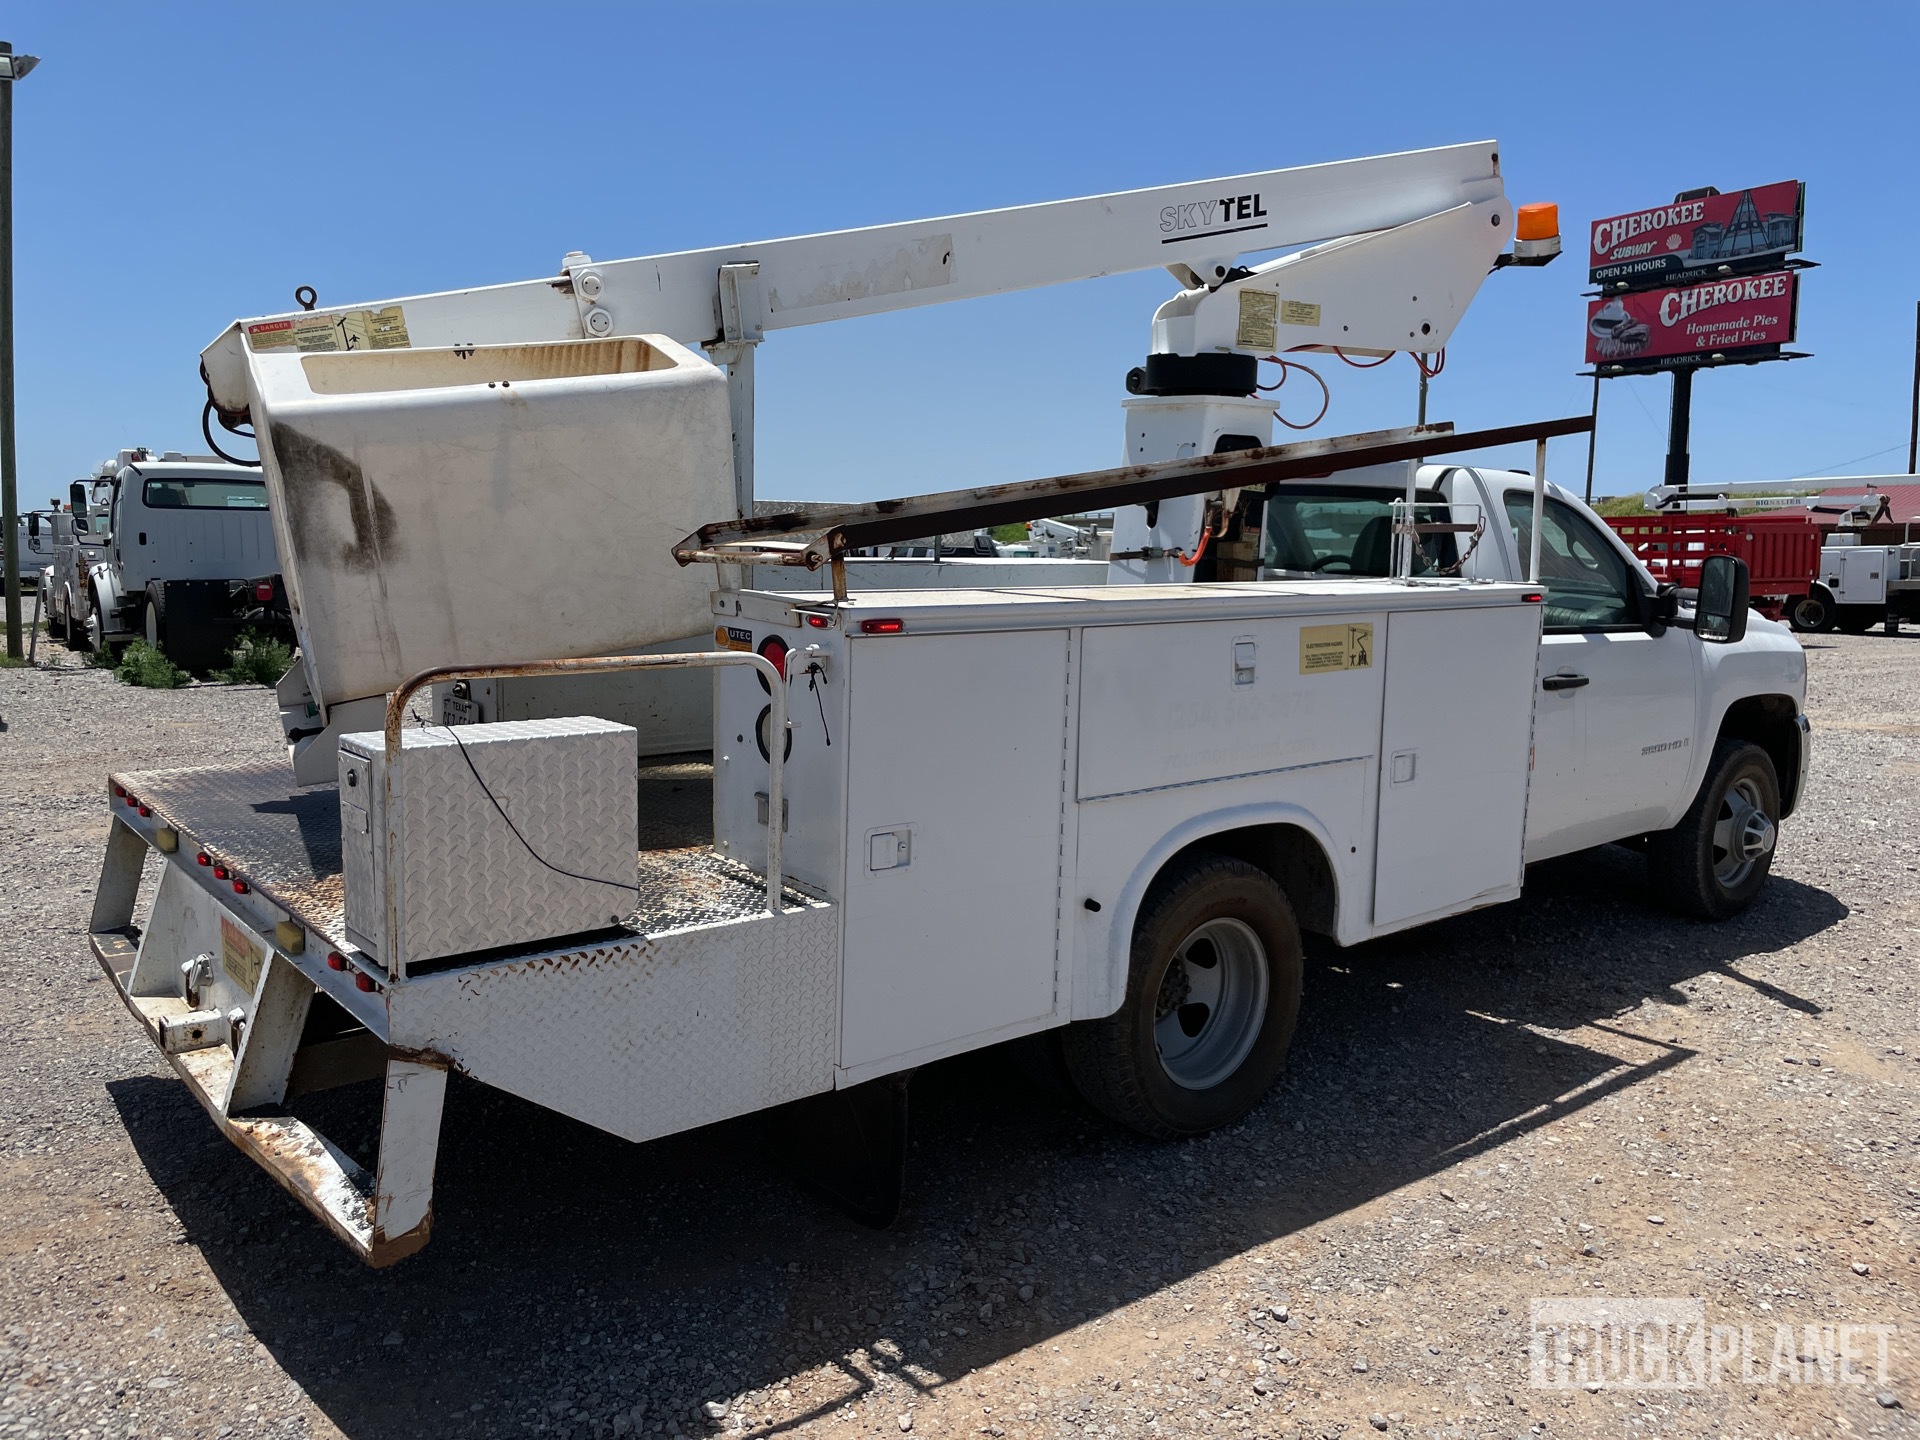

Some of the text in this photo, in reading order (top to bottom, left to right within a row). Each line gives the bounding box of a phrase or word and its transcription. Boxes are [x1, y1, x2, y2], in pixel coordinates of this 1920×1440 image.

[1160, 193, 1267, 232] SKYTEL
[1593, 201, 1705, 255] CHEROKEE
[1610, 240, 1658, 260] SUBWAY
[1596, 258, 1667, 280] OPEN 24 HOURS
[1665, 268, 1707, 281] HEADRICK
[1658, 275, 1787, 327] CHEROKEE
[260, 322, 289, 331] DANGER
[1686, 314, 1779, 335] Homemade Pies
[1695, 329, 1767, 347] & Fried Pies
[1660, 354, 1701, 365] HEADRICK
[730, 629, 751, 640] UTEC
